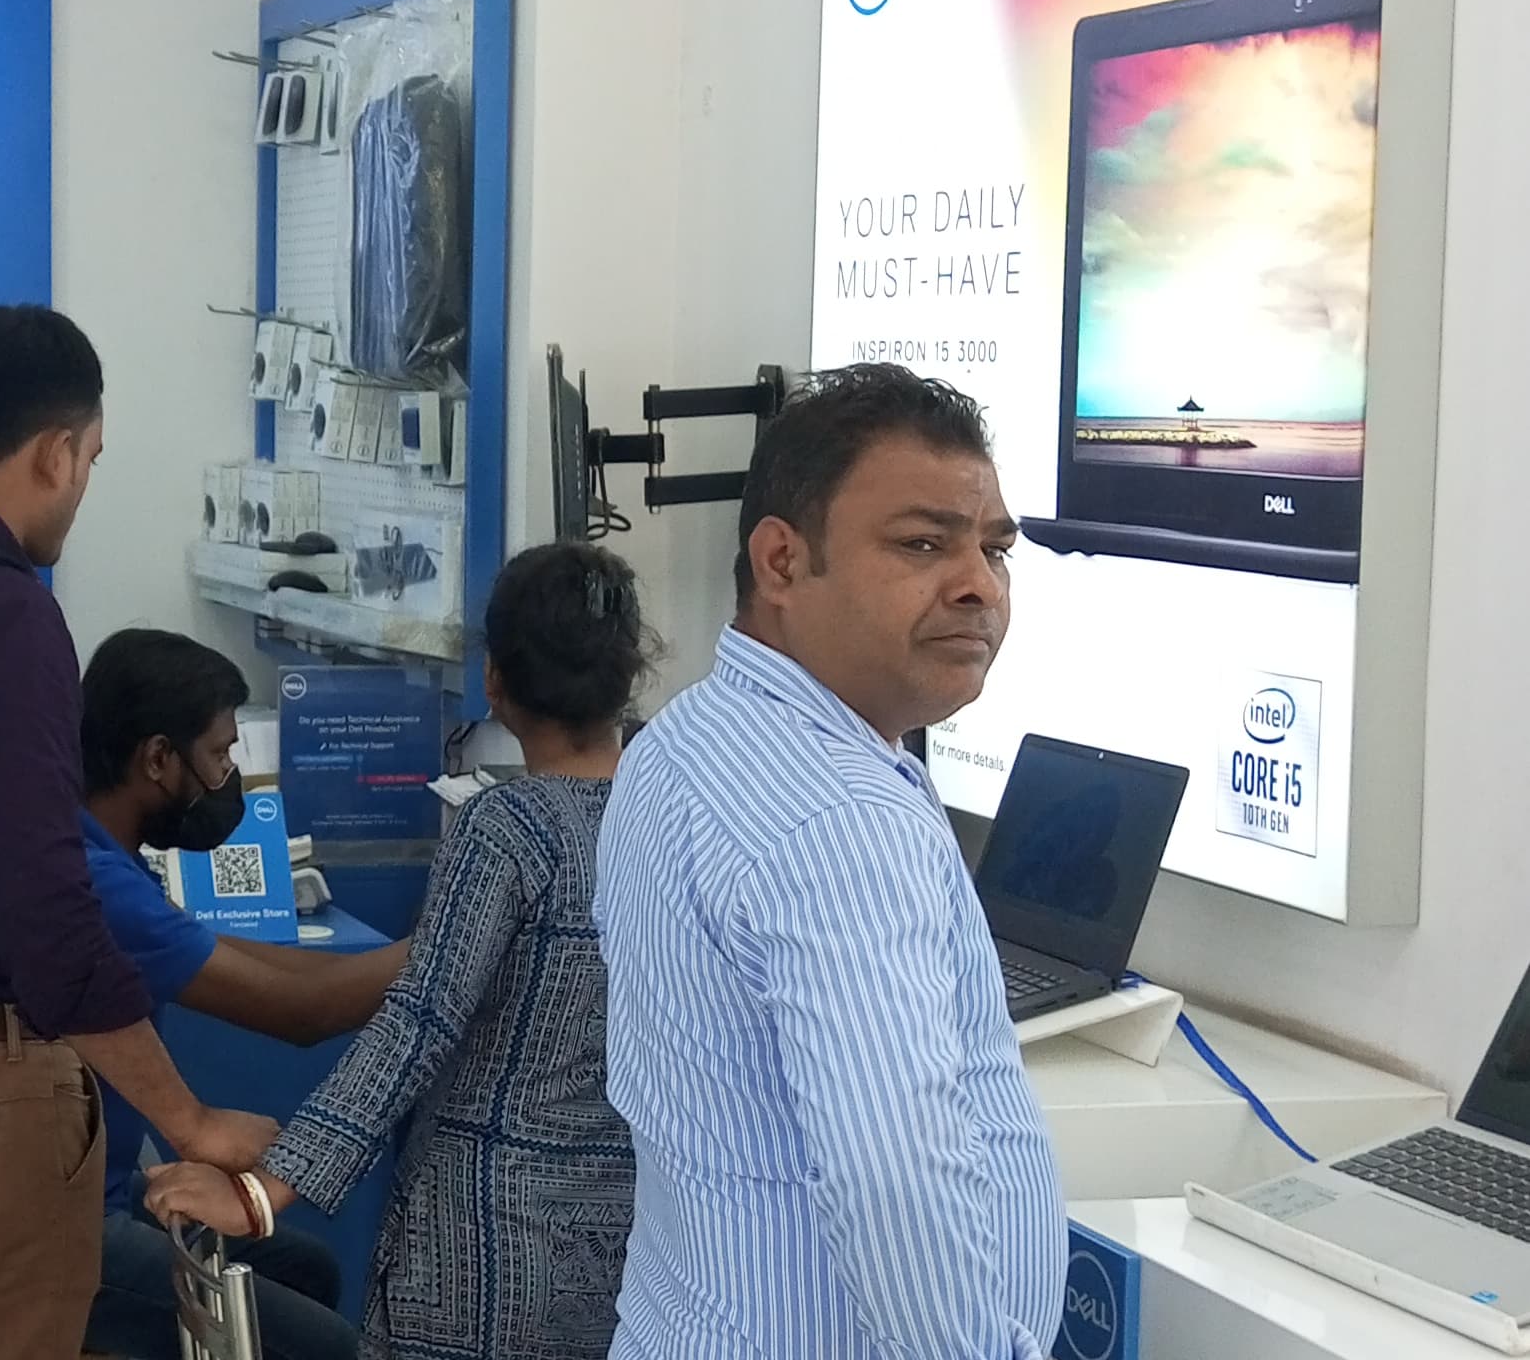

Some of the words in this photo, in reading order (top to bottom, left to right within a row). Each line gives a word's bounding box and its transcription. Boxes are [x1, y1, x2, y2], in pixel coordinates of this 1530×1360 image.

[839, 193, 917, 240] YOUR
[934, 184, 1026, 234] DAILY
[837, 251, 1022, 300] MUST-HAVE
[852, 340, 926, 362] INSPIRON
[935, 340, 949, 362] 15
[957, 340, 997, 363] 3000
[1264, 494, 1296, 515] DELL
[1250, 697, 1286, 729] intel
[933, 739, 945, 756] for
[947, 746, 970, 763] more
[1232, 749, 1279, 802] CORE
[1285, 761, 1302, 808] i5
[1243, 802, 1267, 830] 10TH
[1270, 809, 1289, 833] GEN
[216, 909, 260, 920] Exclusive
[263, 908, 289, 918] Store
[1067, 1285, 1112, 1332] DELL
